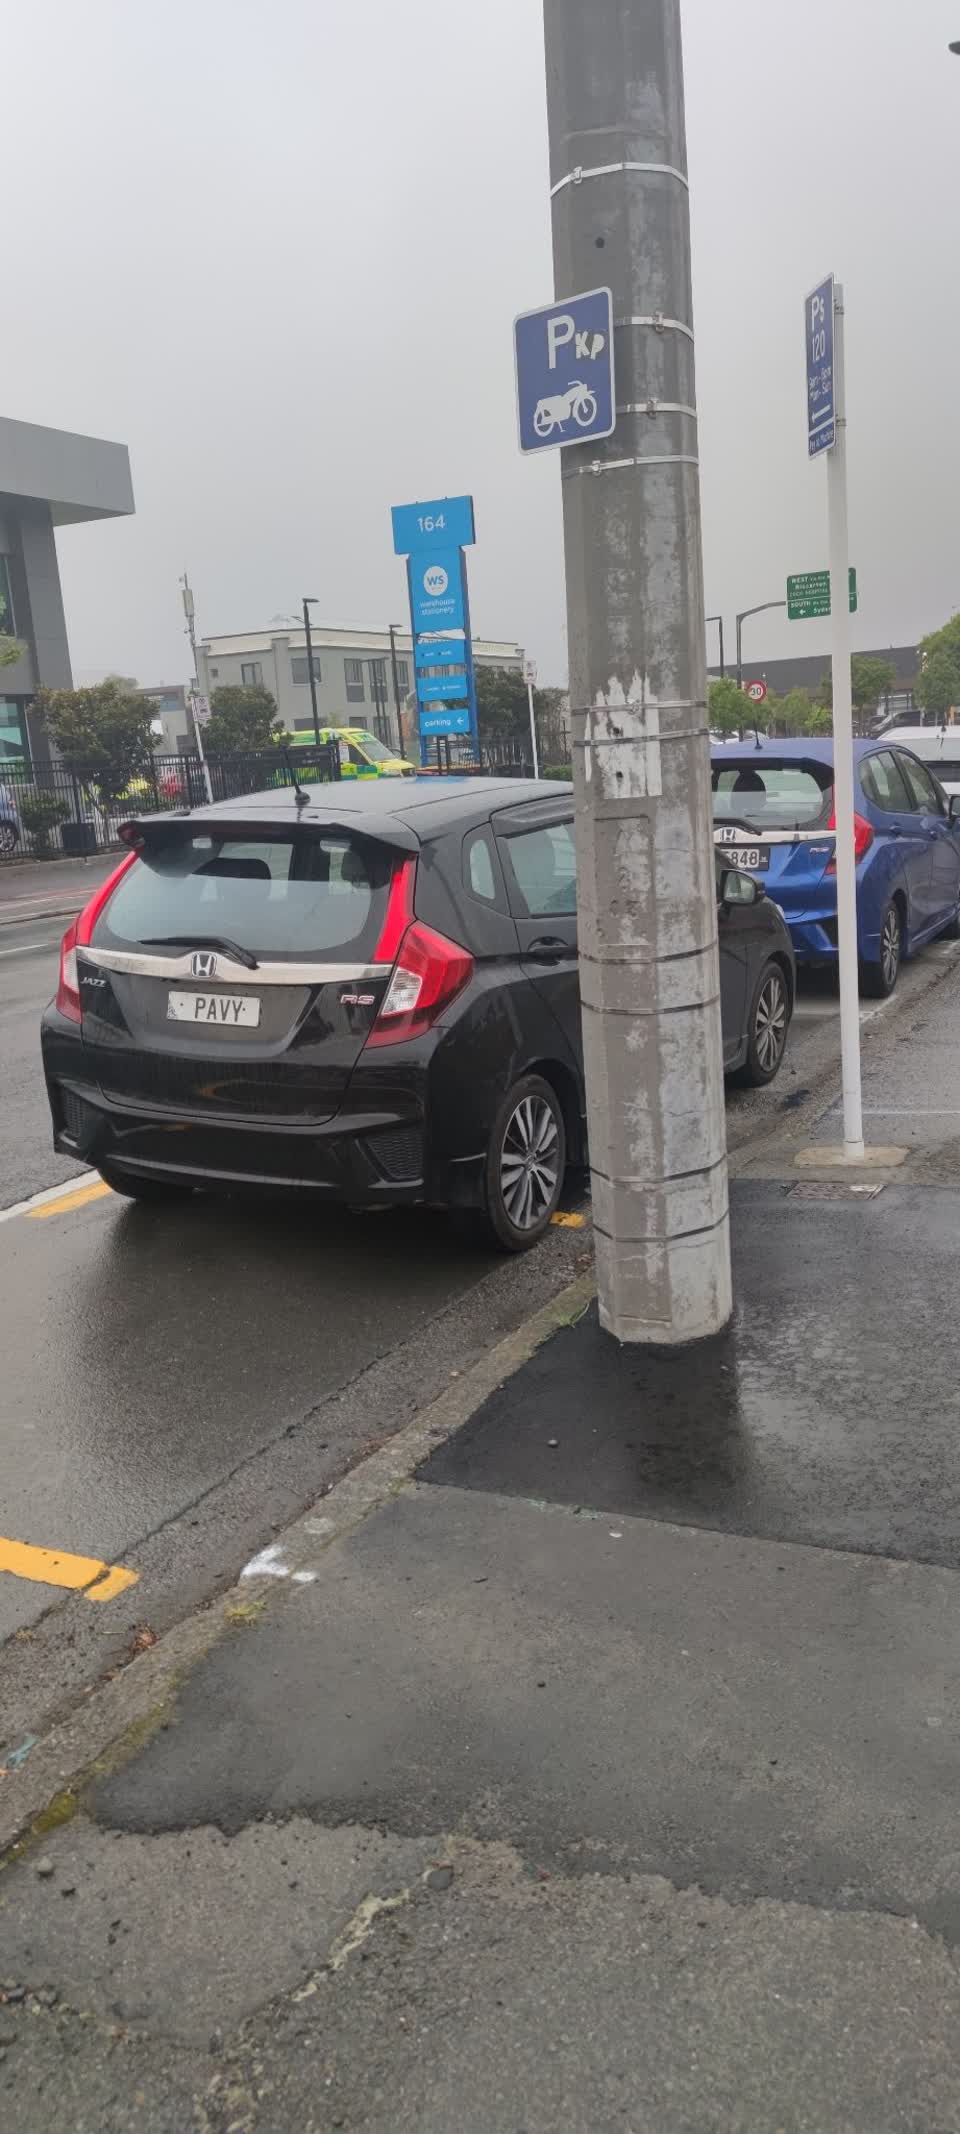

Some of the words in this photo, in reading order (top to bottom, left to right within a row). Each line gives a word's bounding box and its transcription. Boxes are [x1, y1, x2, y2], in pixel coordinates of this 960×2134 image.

[547, 315, 575, 369] P
[811, 329, 825, 363] 120
[417, 514, 446, 533] 164
[427, 575, 444, 586] WS
[419, 598, 456, 609] warehouse
[421, 606, 455, 617] stationery
[751, 687, 761, 696] 30
[425, 719, 451, 728] parking
[80, 976, 106, 988] JAZZ
[341, 994, 375, 1005] RS
[195, 997, 243, 1022] PAVY
